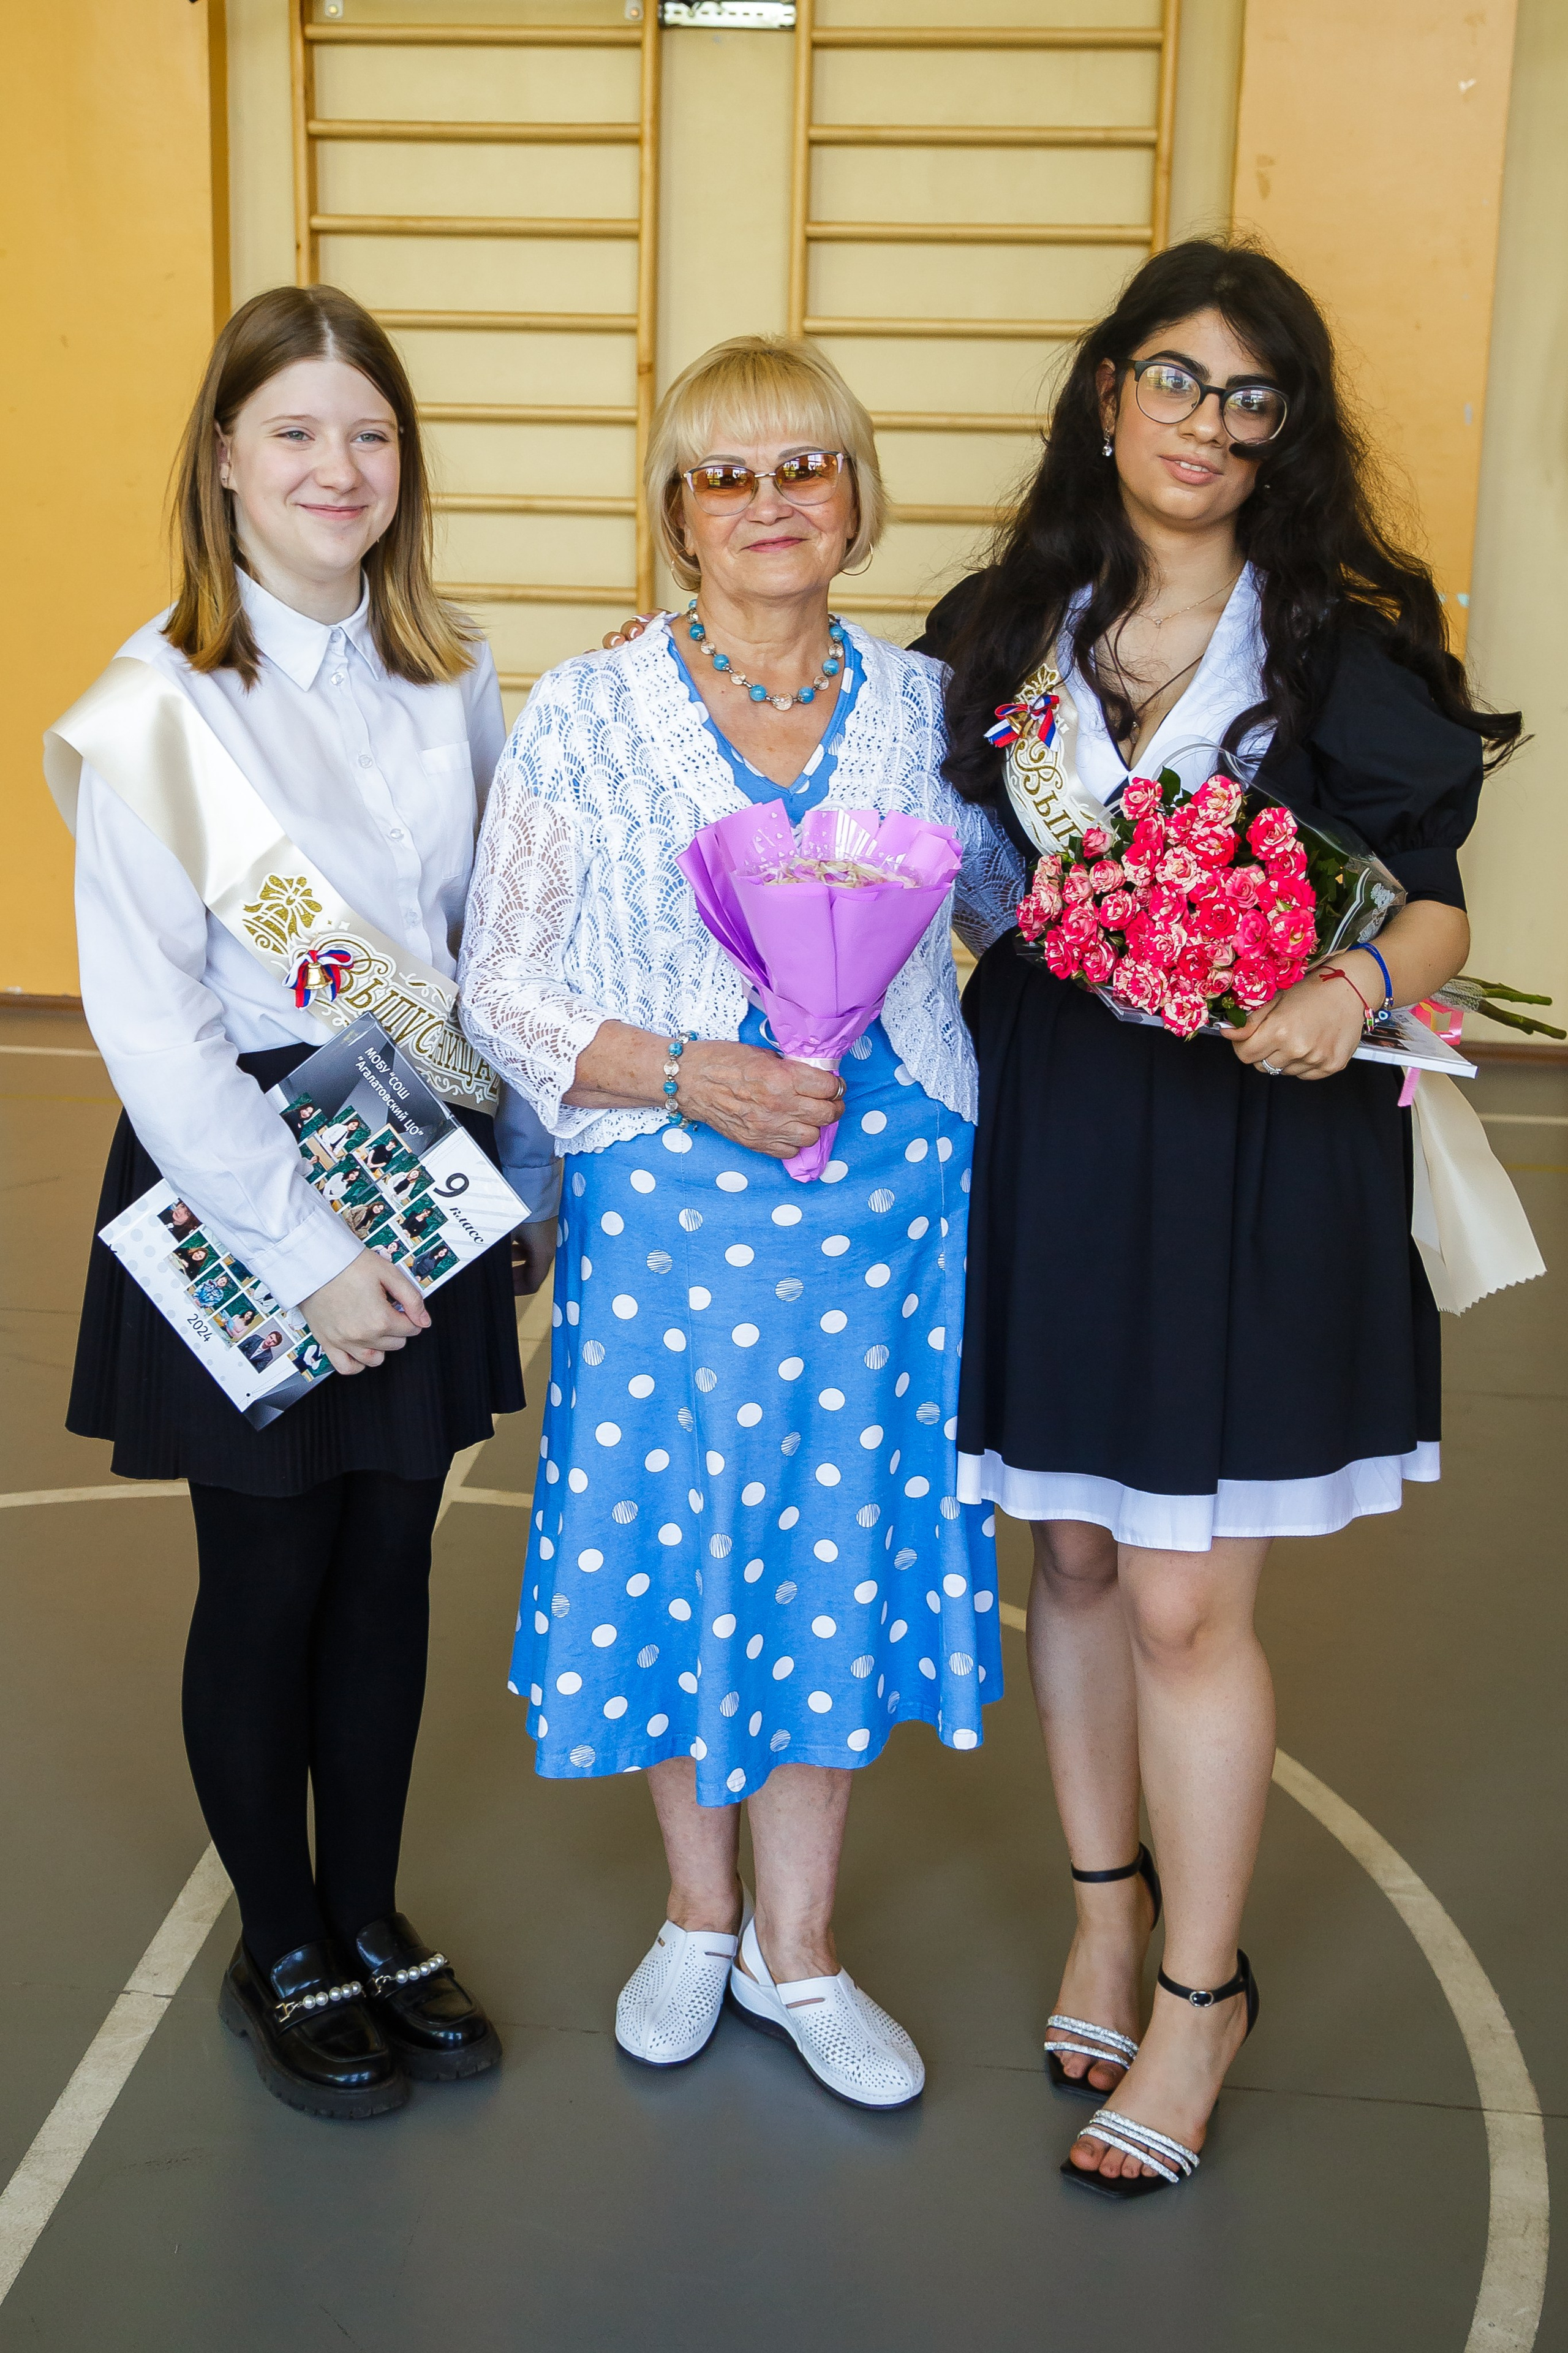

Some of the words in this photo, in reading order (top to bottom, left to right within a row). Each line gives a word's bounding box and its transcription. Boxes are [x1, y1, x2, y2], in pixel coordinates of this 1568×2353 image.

[364, 1047, 390, 1073] МОБУ
[433, 1173, 469, 1198] 9
[449, 1207, 484, 1244] класс
[187, 1313, 213, 1342] 2024
